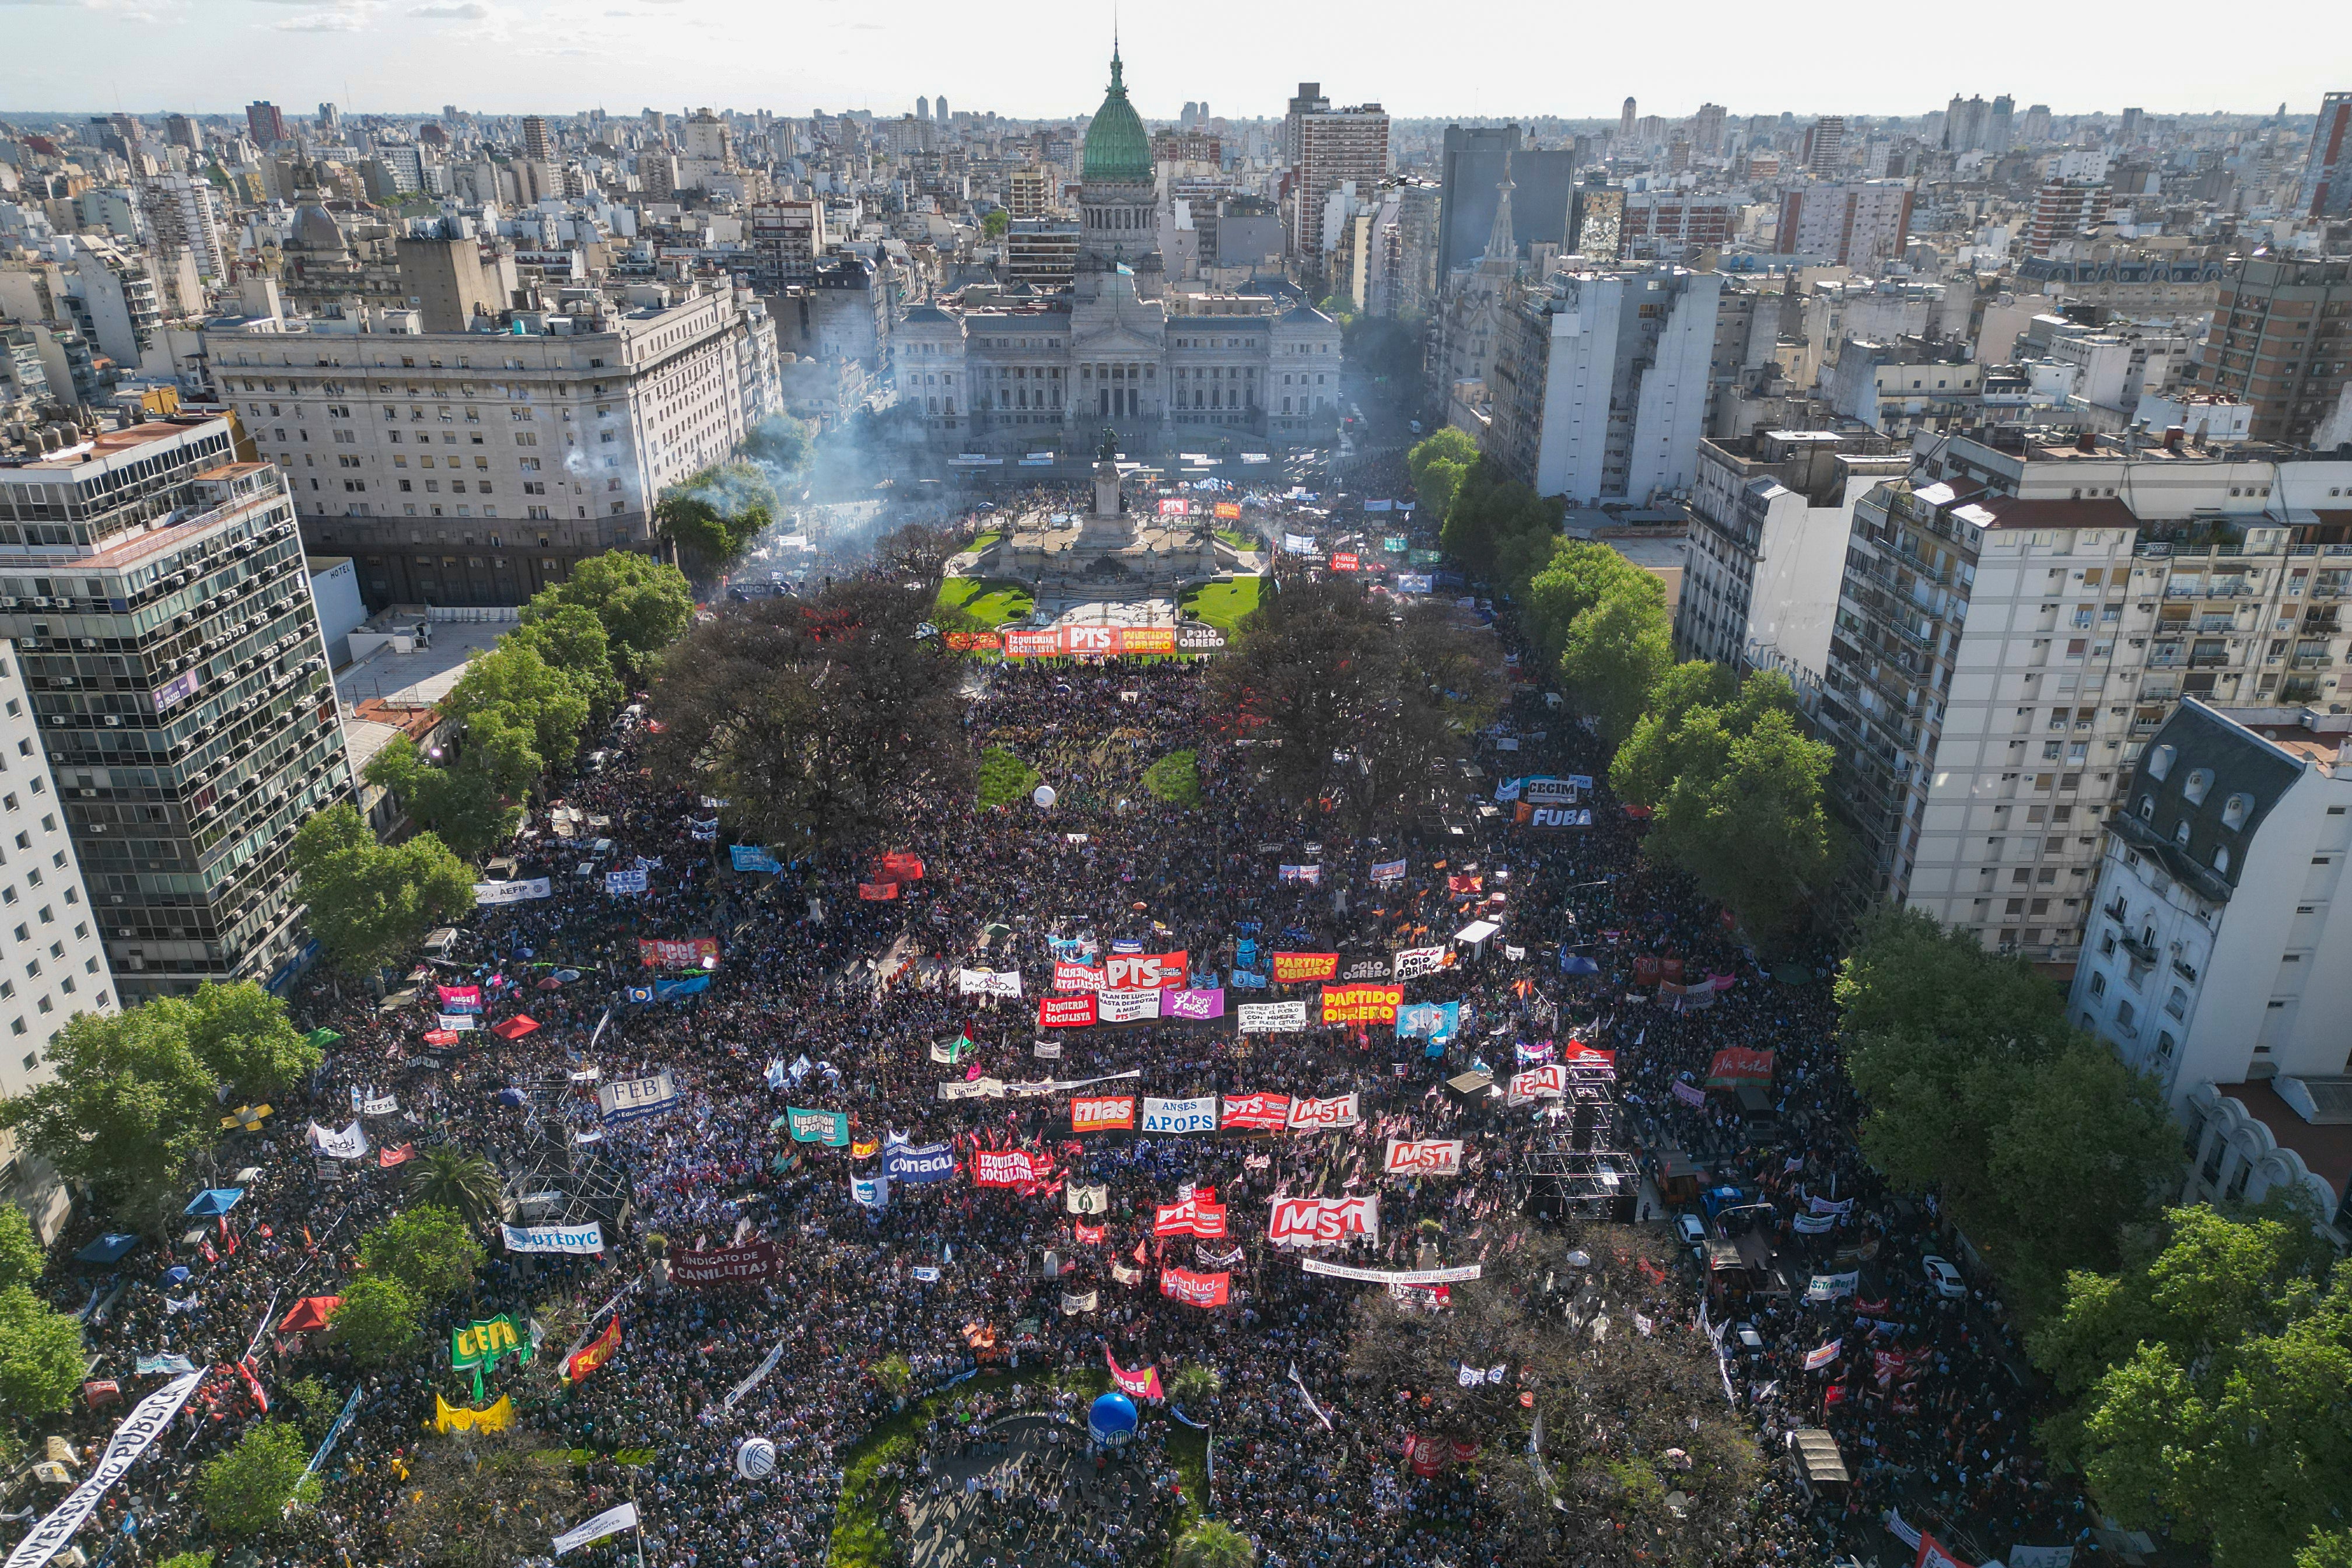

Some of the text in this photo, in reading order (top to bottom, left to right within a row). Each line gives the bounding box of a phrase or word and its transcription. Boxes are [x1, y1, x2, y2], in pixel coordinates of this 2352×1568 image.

[330, 564, 351, 579] HOTEL
[741, 585, 766, 594] UPCN
[1009, 635, 1054, 644] IZQUIERDA
[1070, 627, 1111, 649] PTS
[1123, 631, 1172, 640] PARTIDO
[1186, 629, 1217, 639] POLO
[1009, 644, 1055, 653] SOCIALISTA
[1125, 640, 1171, 650] OBRERO
[1179, 638, 1225, 648] OBRERO
[1529, 782, 1575, 795] CECIM
[1532, 809, 1592, 826] FUBA
[610, 871, 642, 883] CCC
[499, 885, 527, 895] AEFIP
[1275, 957, 1335, 967] PARTIDO
[1350, 961, 1384, 972] POLO
[1403, 957, 1430, 967] POLO
[1107, 957, 1162, 987] PTS
[1277, 965, 1332, 979] OBRERO
[1343, 968, 1391, 980] OBRERO
[1100, 997, 1158, 1006] HASTA DERROTAR
[1325, 991, 1400, 1006] PARTIDO
[1046, 1000, 1089, 1013] IZQUIERDA
[1324, 1006, 1394, 1021] OBRERO
[1045, 1011, 1091, 1023] SOCIALISTA
[612, 1080, 657, 1101] FEB
[365, 1100, 395, 1112] CEFyL
[621, 1107, 654, 1118] Educación
[1079, 1100, 1132, 1121] mas
[1162, 1101, 1197, 1112] ANSES
[1224, 1096, 1263, 1115] PTS
[1296, 1097, 1350, 1123] MST
[1146, 1115, 1213, 1131] APOPS
[416, 1127, 448, 1149] FADU
[980, 1152, 1031, 1170] IZQUIERDA
[1396, 1145, 1452, 1167] MST
[980, 1167, 1034, 1182] SOCIALISTA
[1158, 1200, 1195, 1223] PTS
[1278, 1200, 1366, 1240] MST
[533, 1230, 599, 1247] UTEDYC
[681, 1251, 758, 1266] SINDICATO DE
[677, 1259, 768, 1282] CANILLITAS
[1161, 1272, 1214, 1292] Juventud
[1396, 1283, 1436, 1294] Democracia
[1167, 1283, 1191, 1301] PTS
[458, 1321, 518, 1356] CEPA
[753, 1447, 774, 1474] ATE
[579, 1517, 601, 1532] UNION
